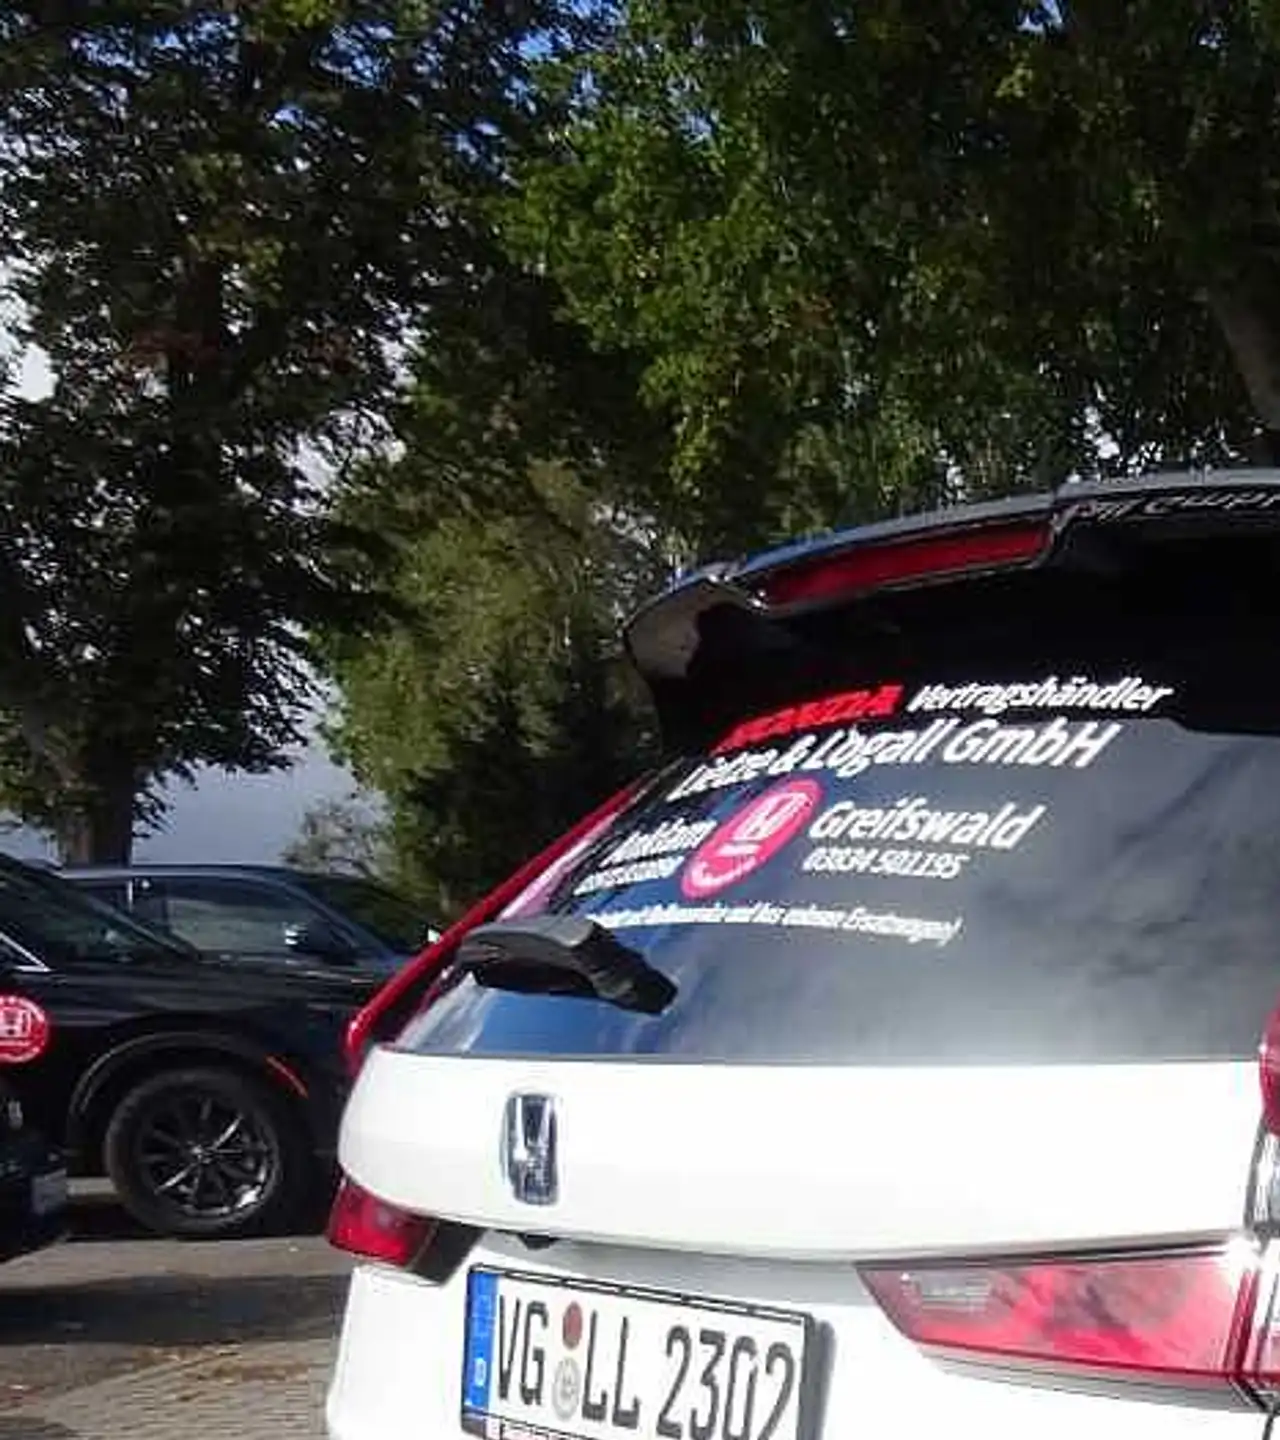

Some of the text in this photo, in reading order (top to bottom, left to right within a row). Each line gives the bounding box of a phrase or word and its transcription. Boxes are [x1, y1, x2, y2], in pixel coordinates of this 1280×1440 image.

[906, 676, 1174, 714] Vertragshändler
[768, 733, 817, 775] &
[801, 717, 960, 778] Logall
[944, 716, 1123, 769] GmbH
[809, 797, 1047, 850] Greifswald
[498, 1293, 550, 1407] VG
[581, 1309, 641, 1430] LL
